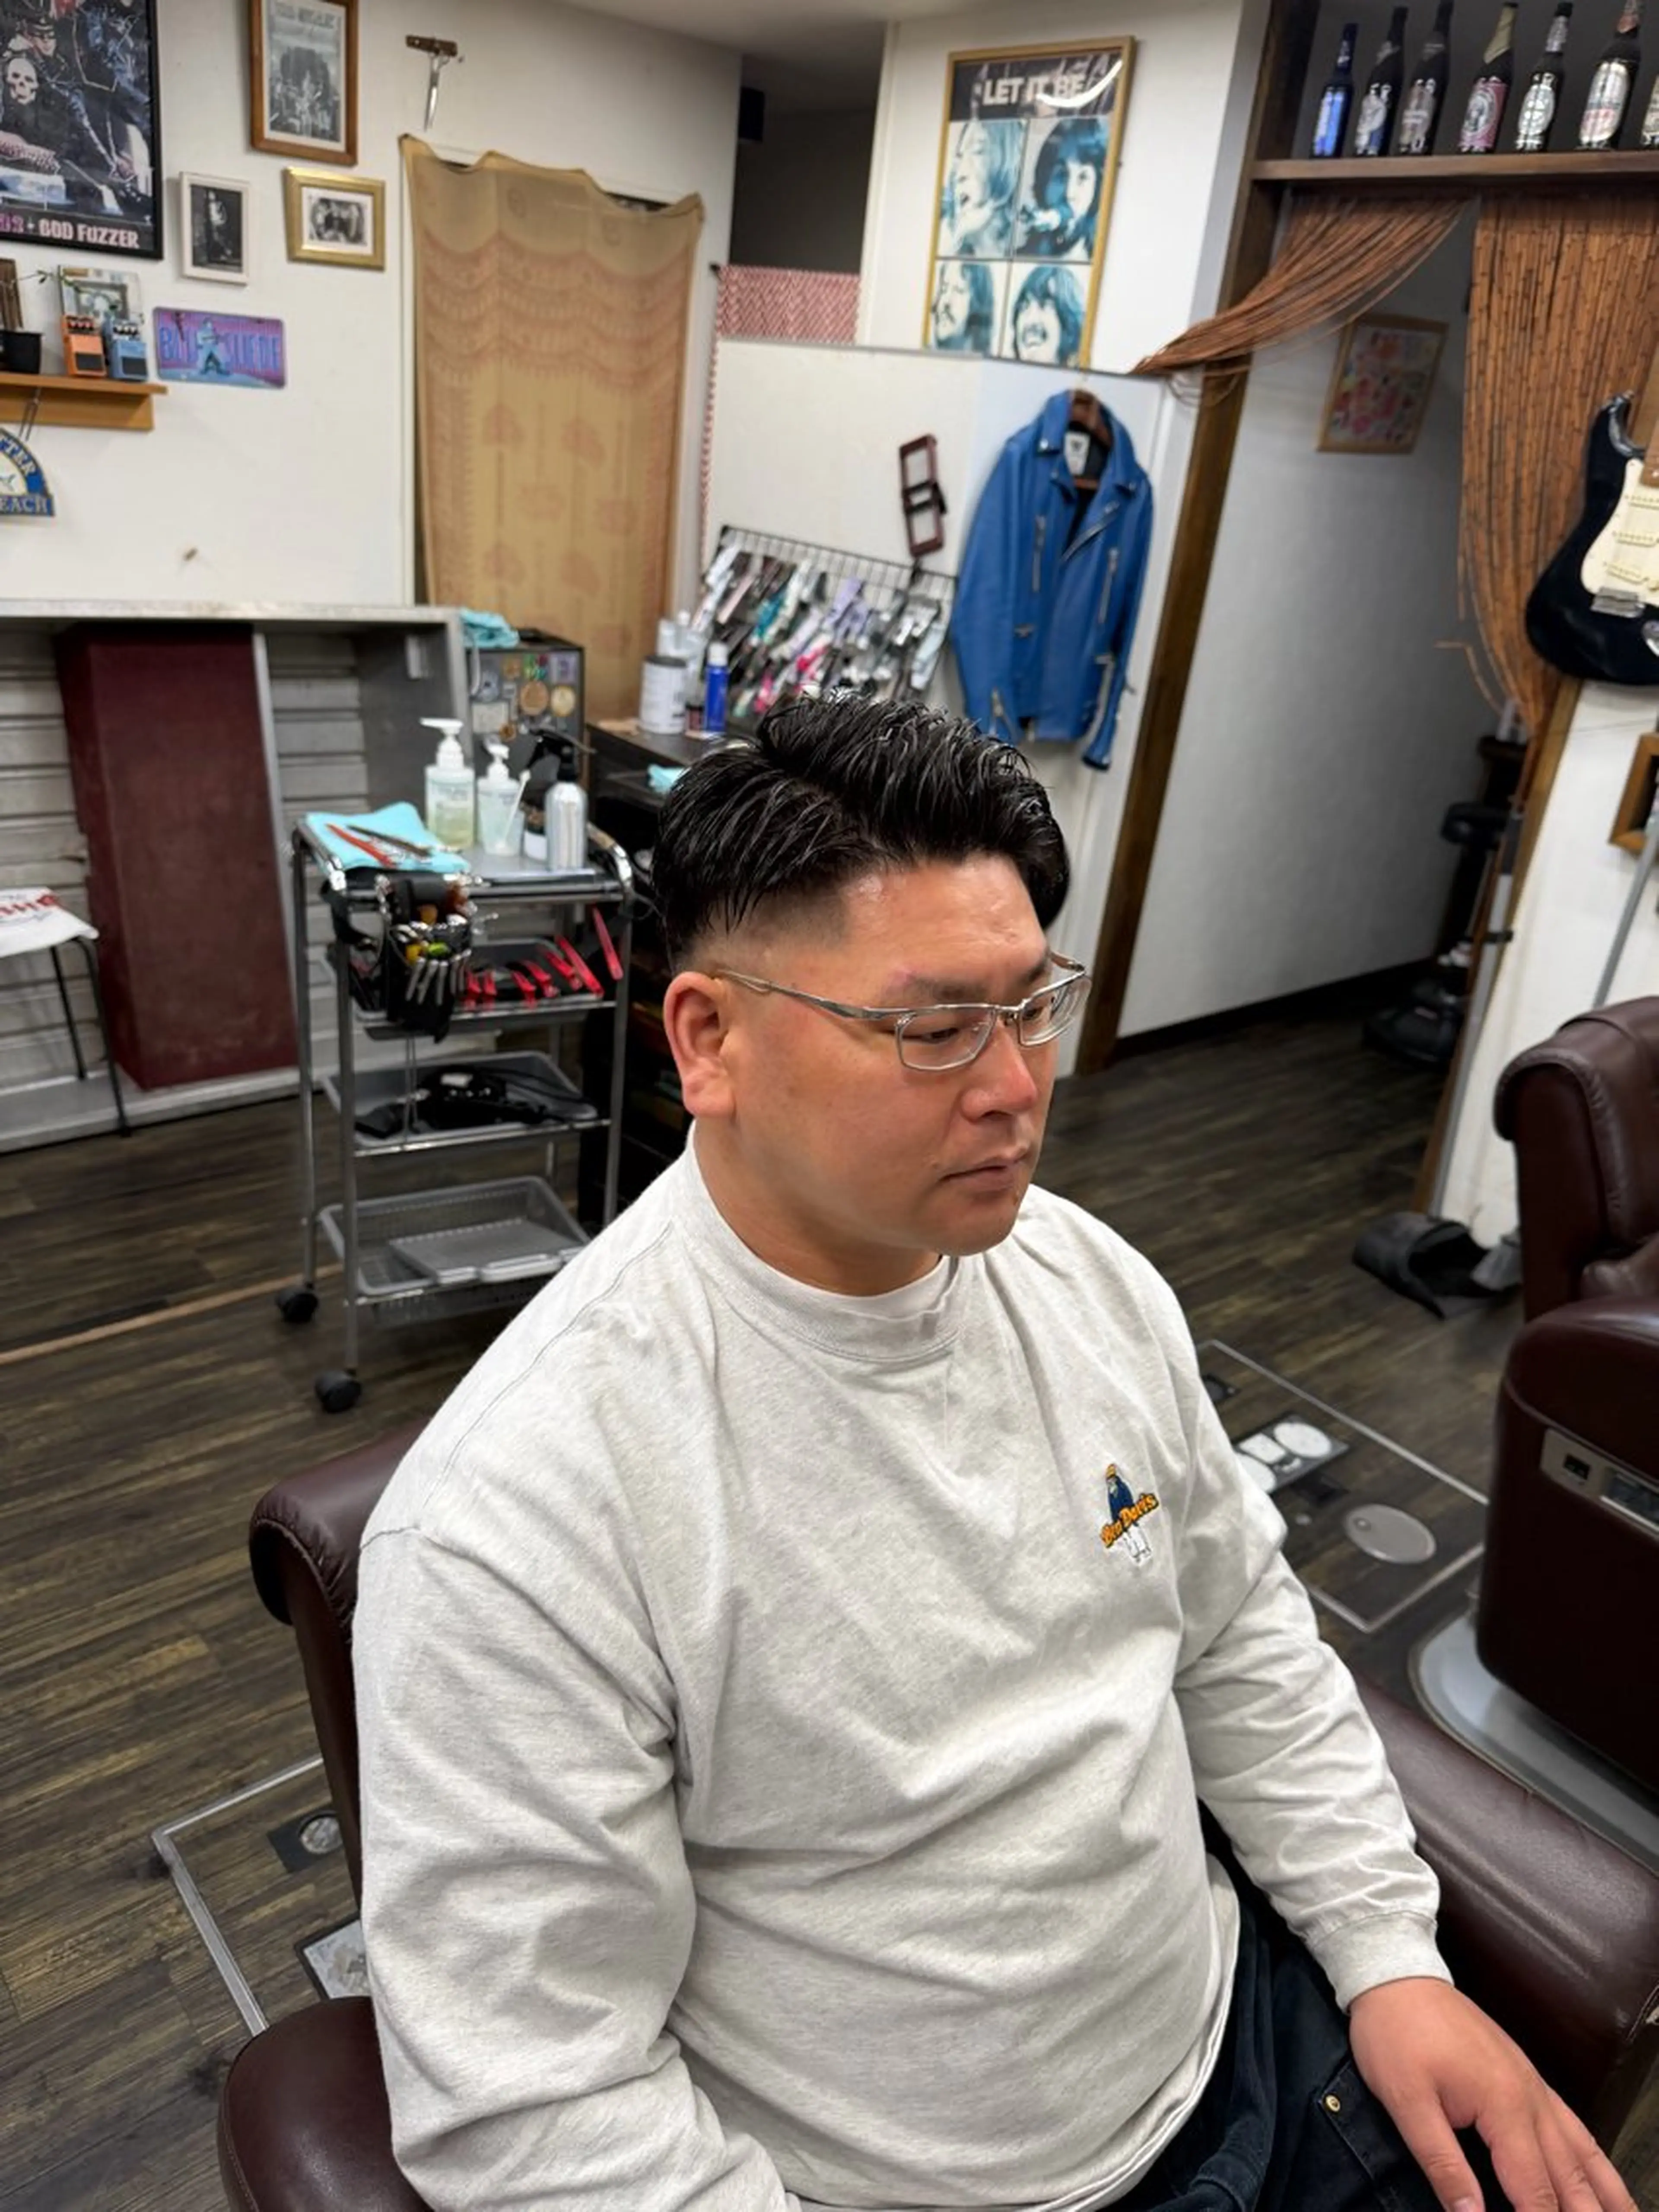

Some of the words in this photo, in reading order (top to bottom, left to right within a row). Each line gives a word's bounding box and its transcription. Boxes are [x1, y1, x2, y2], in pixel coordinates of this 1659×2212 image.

[982, 78, 1025, 105] LET
[1024, 75, 1051, 103] IT
[1052, 73, 1087, 100] BE
[76, 223, 140, 249] FUZZER
